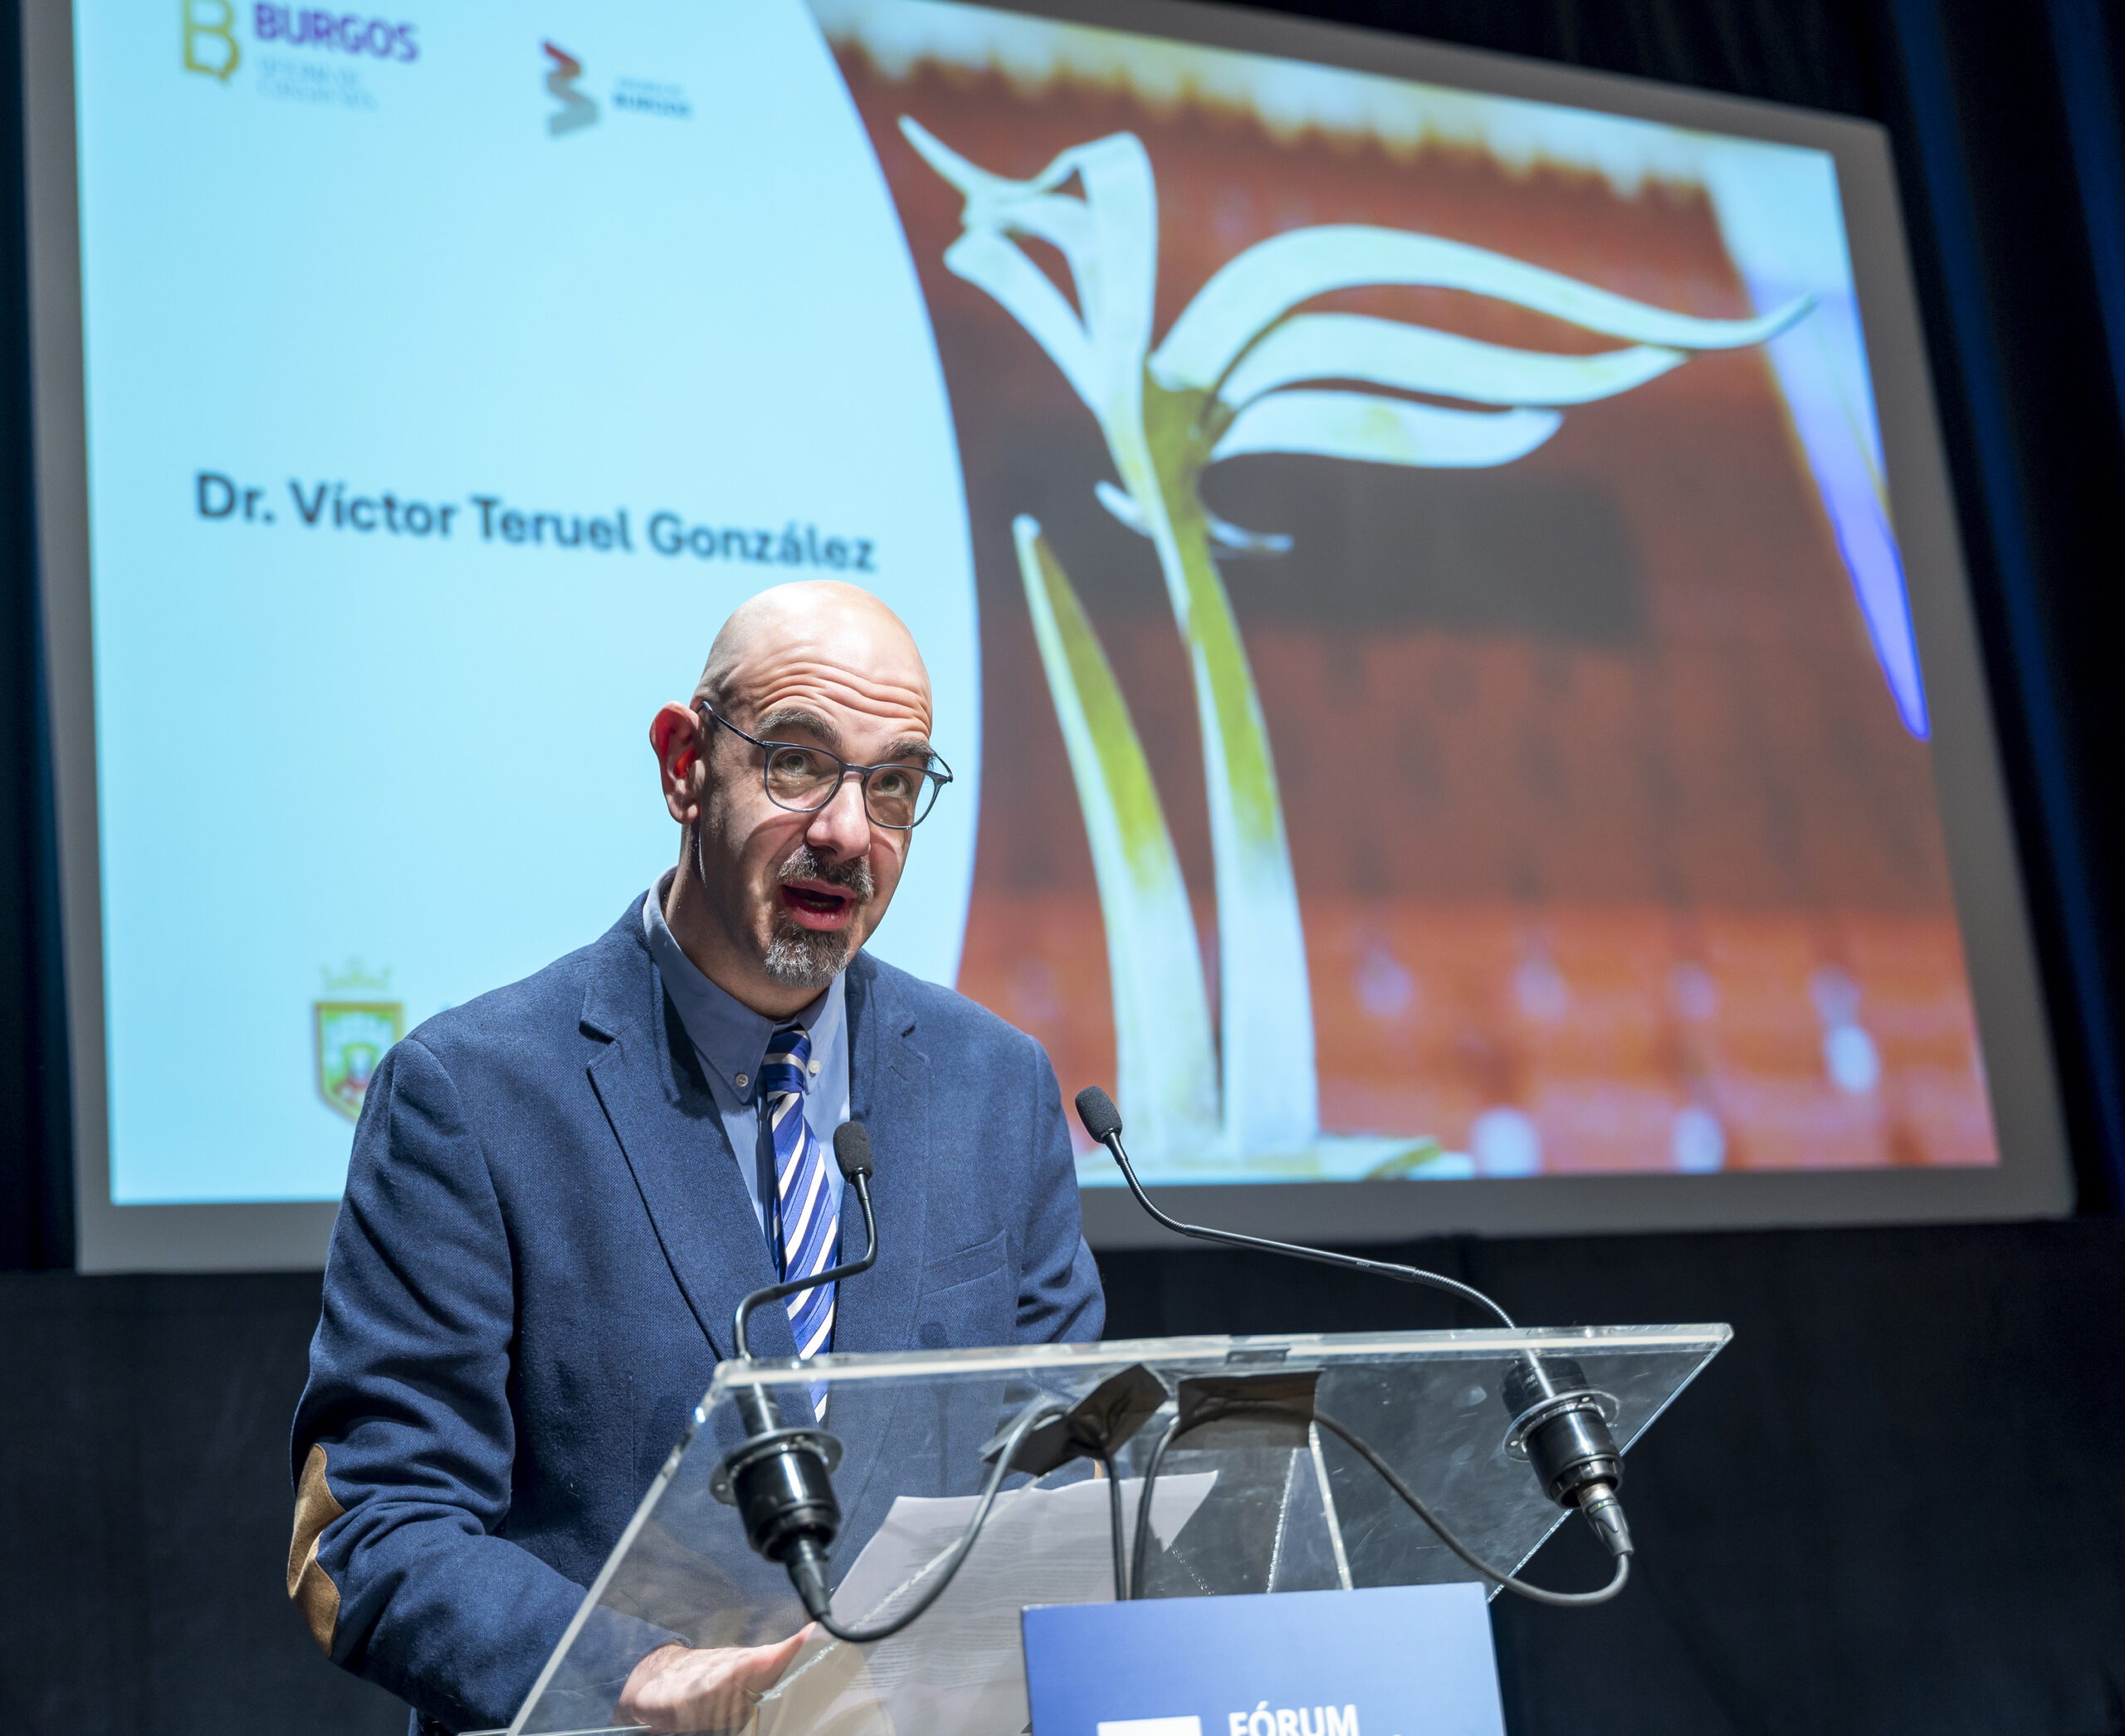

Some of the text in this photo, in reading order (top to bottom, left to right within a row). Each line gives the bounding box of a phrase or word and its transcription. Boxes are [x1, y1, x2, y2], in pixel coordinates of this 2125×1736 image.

[254, 2, 421, 64] BURGOS
[196, 472, 877, 575] Dr. Víctor Teruel González
[1229, 1699, 1359, 1736] FÓRUM
